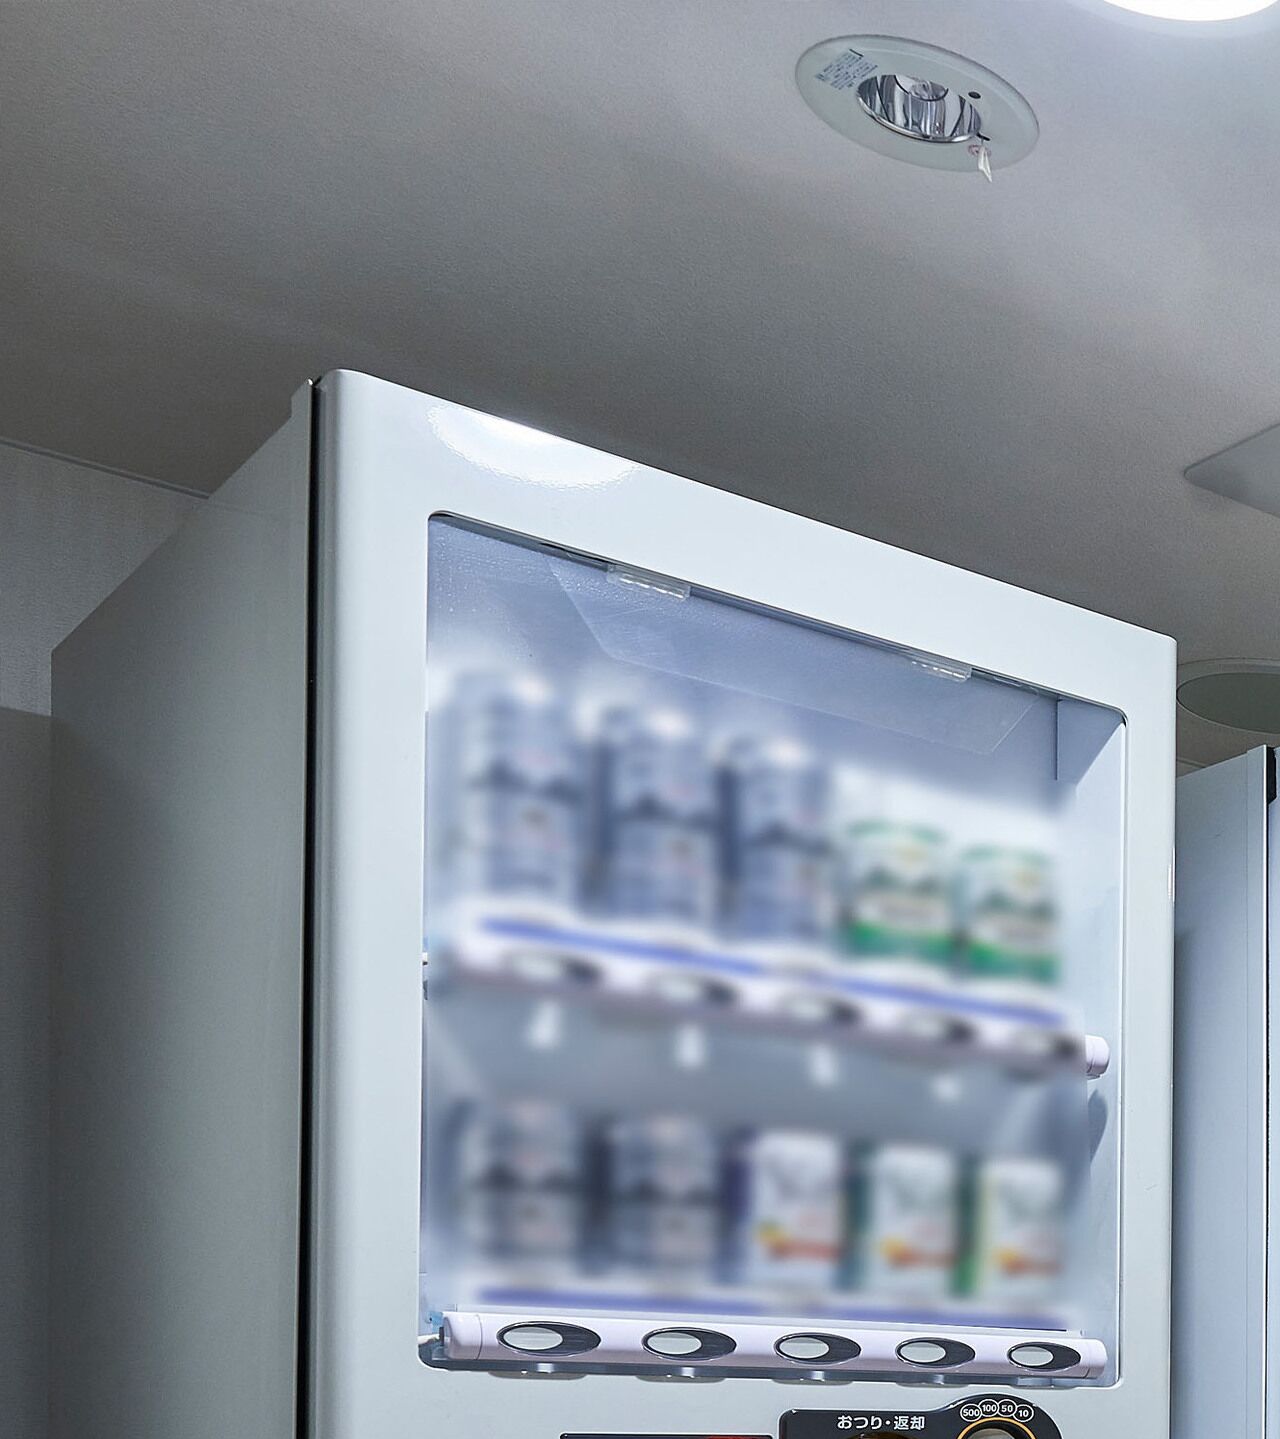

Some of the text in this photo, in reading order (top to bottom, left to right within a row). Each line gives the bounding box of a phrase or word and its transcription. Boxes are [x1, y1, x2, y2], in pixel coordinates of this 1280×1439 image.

[962, 1404, 1029, 1418] 500 100 50 10
[837, 1415, 926, 1430] おつり・返却
